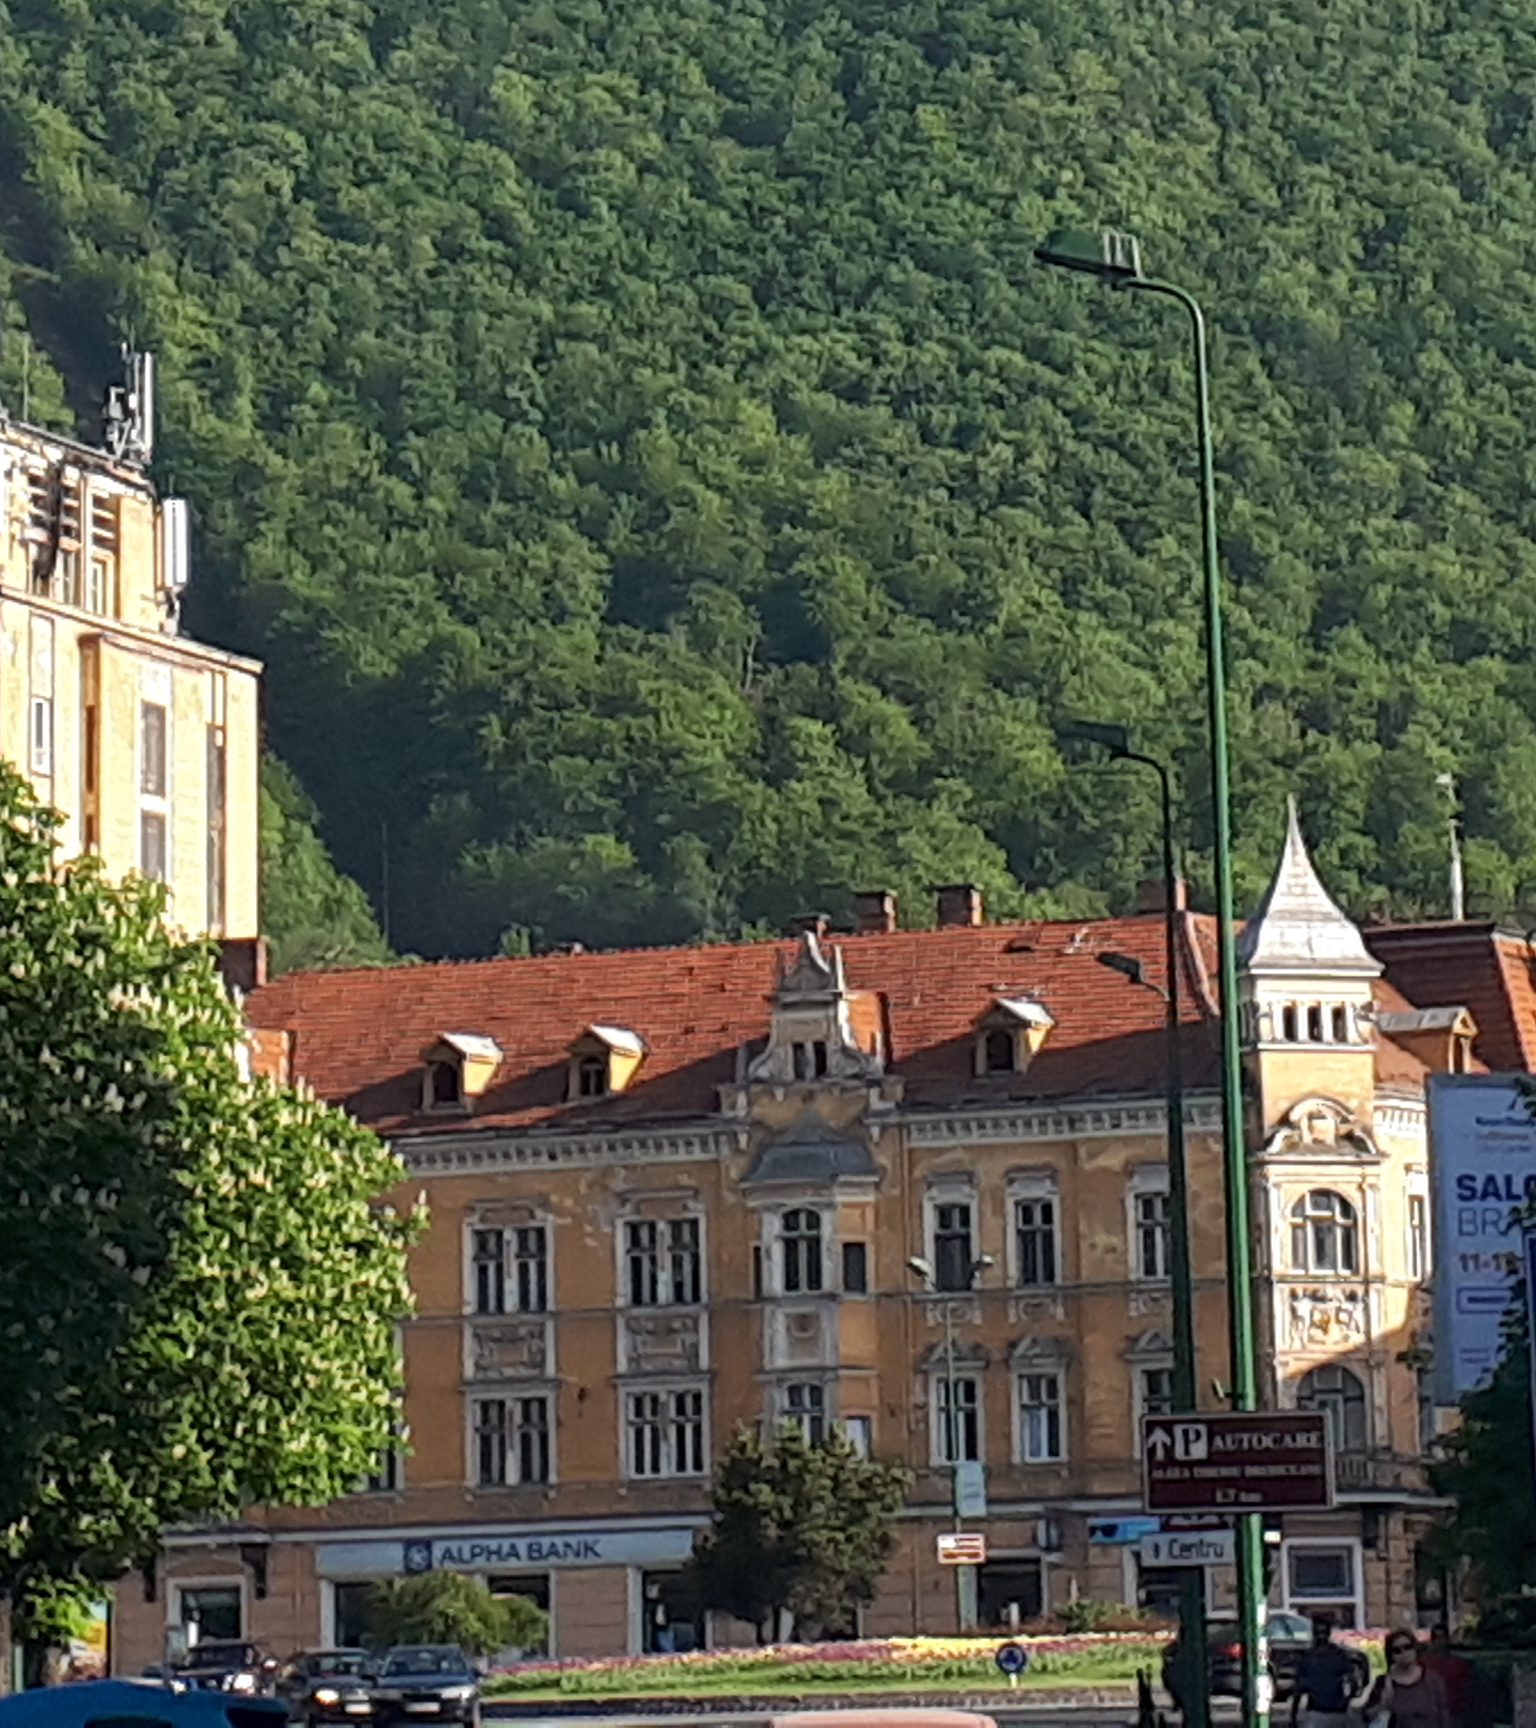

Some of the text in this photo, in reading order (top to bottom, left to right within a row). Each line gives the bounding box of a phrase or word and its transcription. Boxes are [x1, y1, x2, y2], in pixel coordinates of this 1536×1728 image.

[1213, 1431, 1323, 1450] AUTOCARE
[440, 1537, 603, 1566] ALPHA BANK
[1168, 1538, 1224, 1560] Centru
